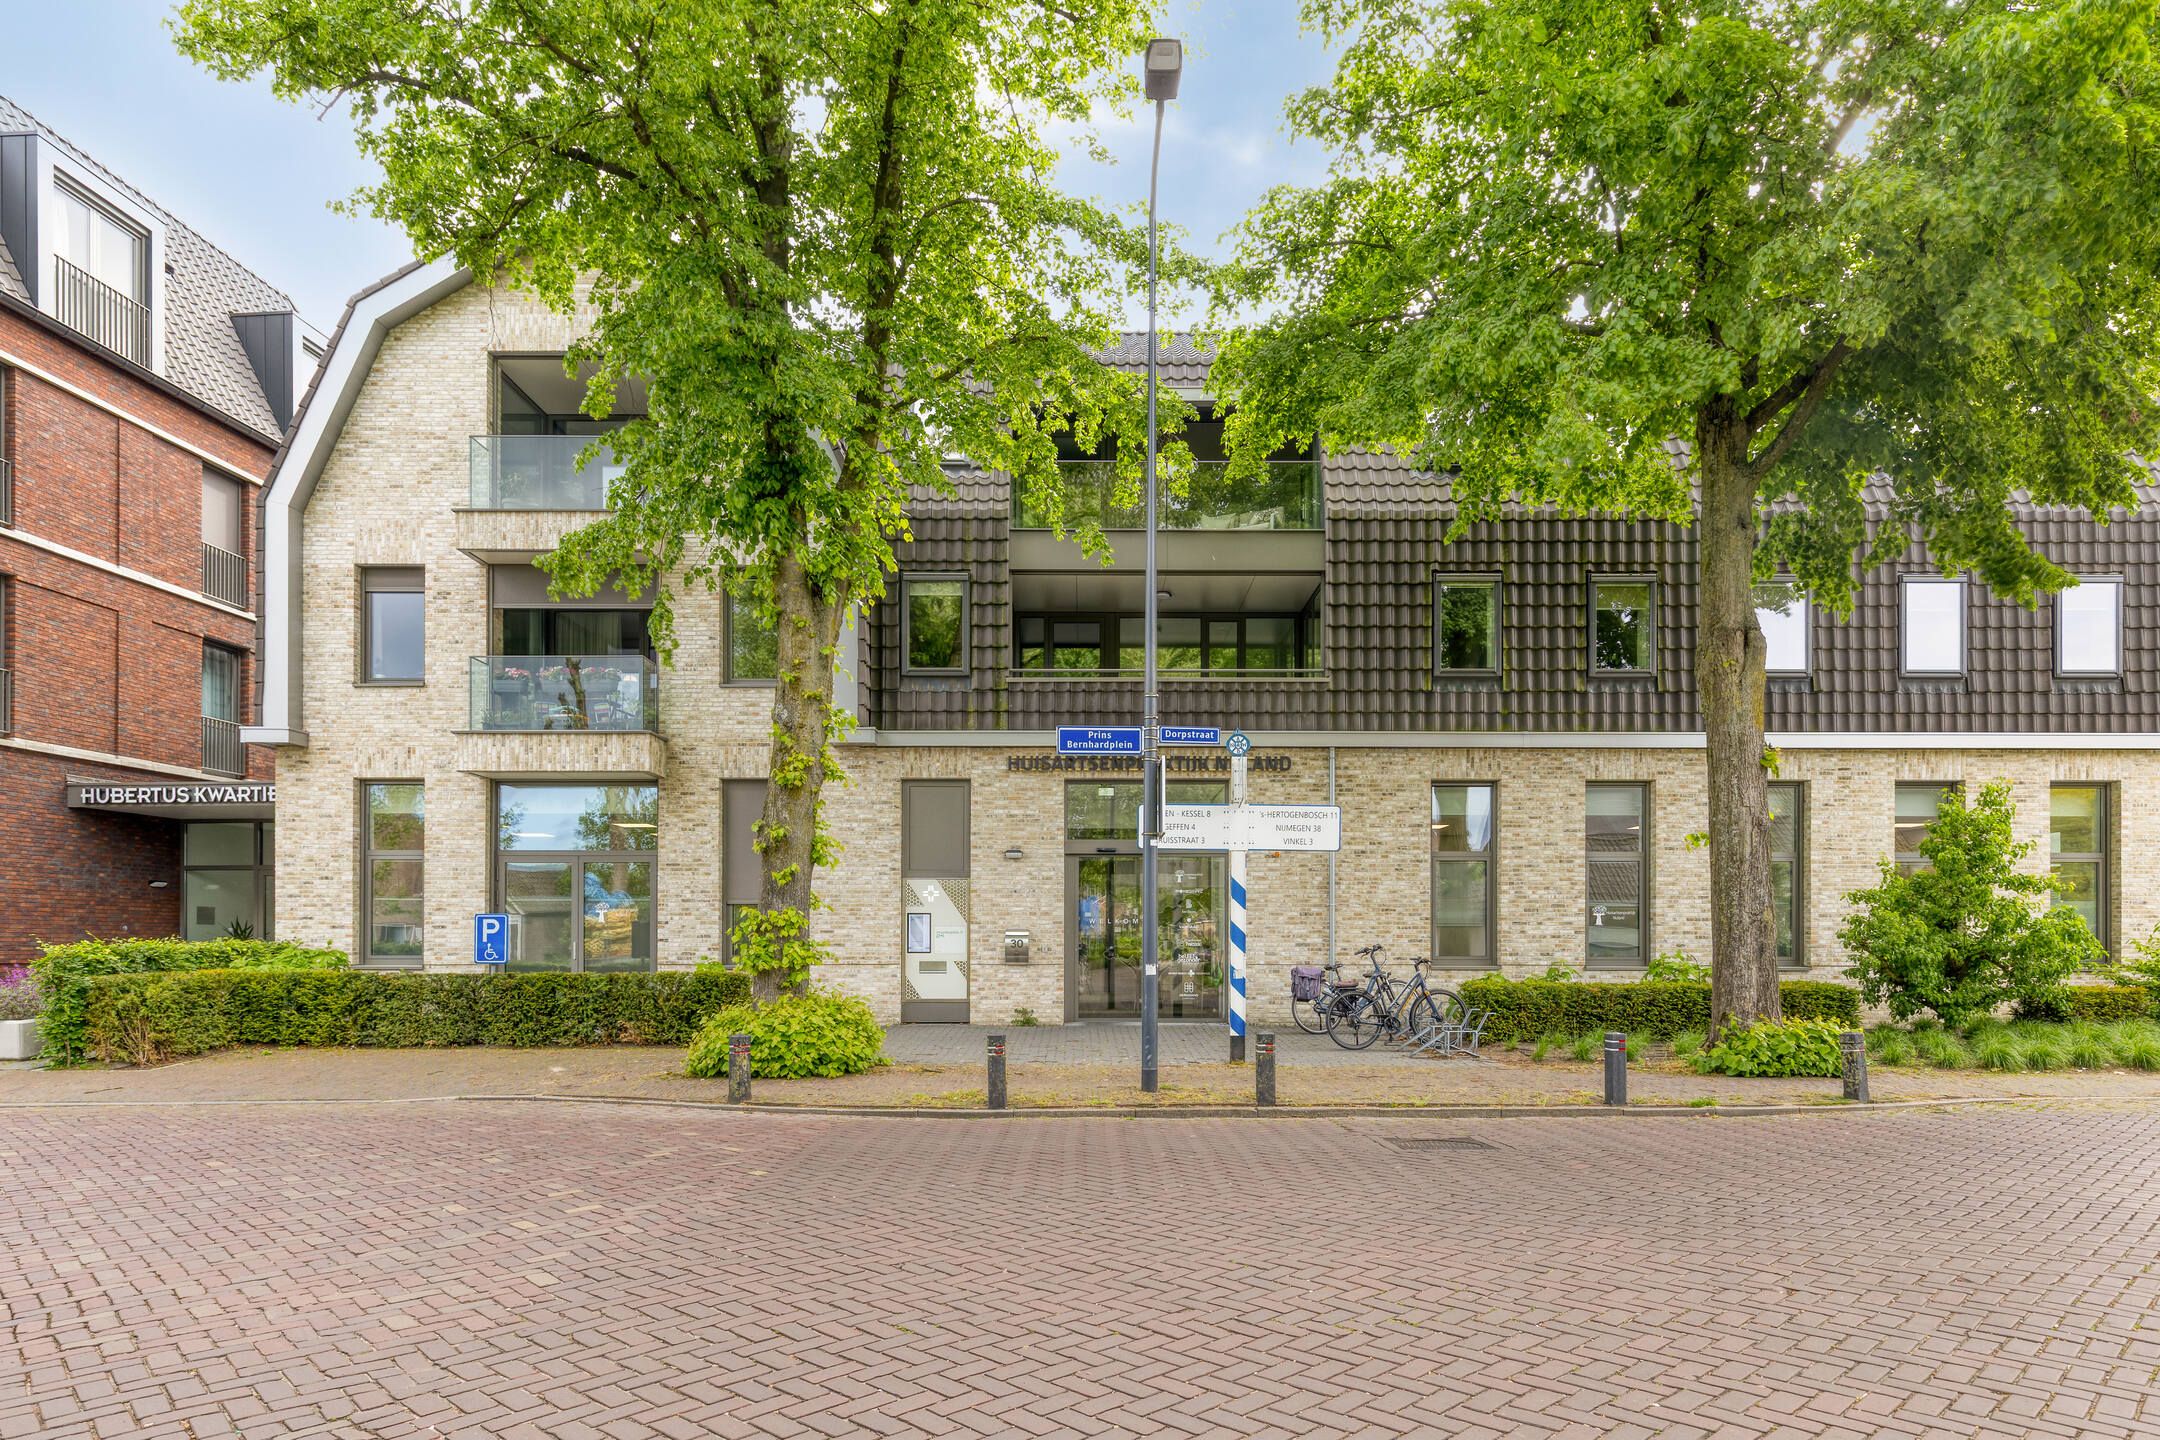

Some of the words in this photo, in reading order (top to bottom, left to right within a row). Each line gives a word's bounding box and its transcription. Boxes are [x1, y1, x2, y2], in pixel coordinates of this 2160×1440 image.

[1088, 731, 1112, 739] Prins
[1164, 729, 1215, 740] Dorpstraat
[1067, 740, 1133, 751] Bernhardplein
[1008, 755, 1210, 771] HUISARTSENPKTIJK
[1215, 755, 1292, 771] NAND
[81, 787, 190, 804] HUBERTUS
[1181, 809, 1205, 818] KESSEL
[1206, 810, 1212, 818] 8
[1330, 812, 1338, 820] 11
[1190, 823, 1196, 831] 4
[1313, 825, 1322, 833] 38
[1158, 836, 1199, 844] RUISSTRAAT
[1200, 837, 1206, 845] 3
[1282, 838, 1308, 846] VINKEL
[1308, 838, 1314, 846] 3
[482, 918, 500, 943] P
[1010, 939, 1024, 949] 30
